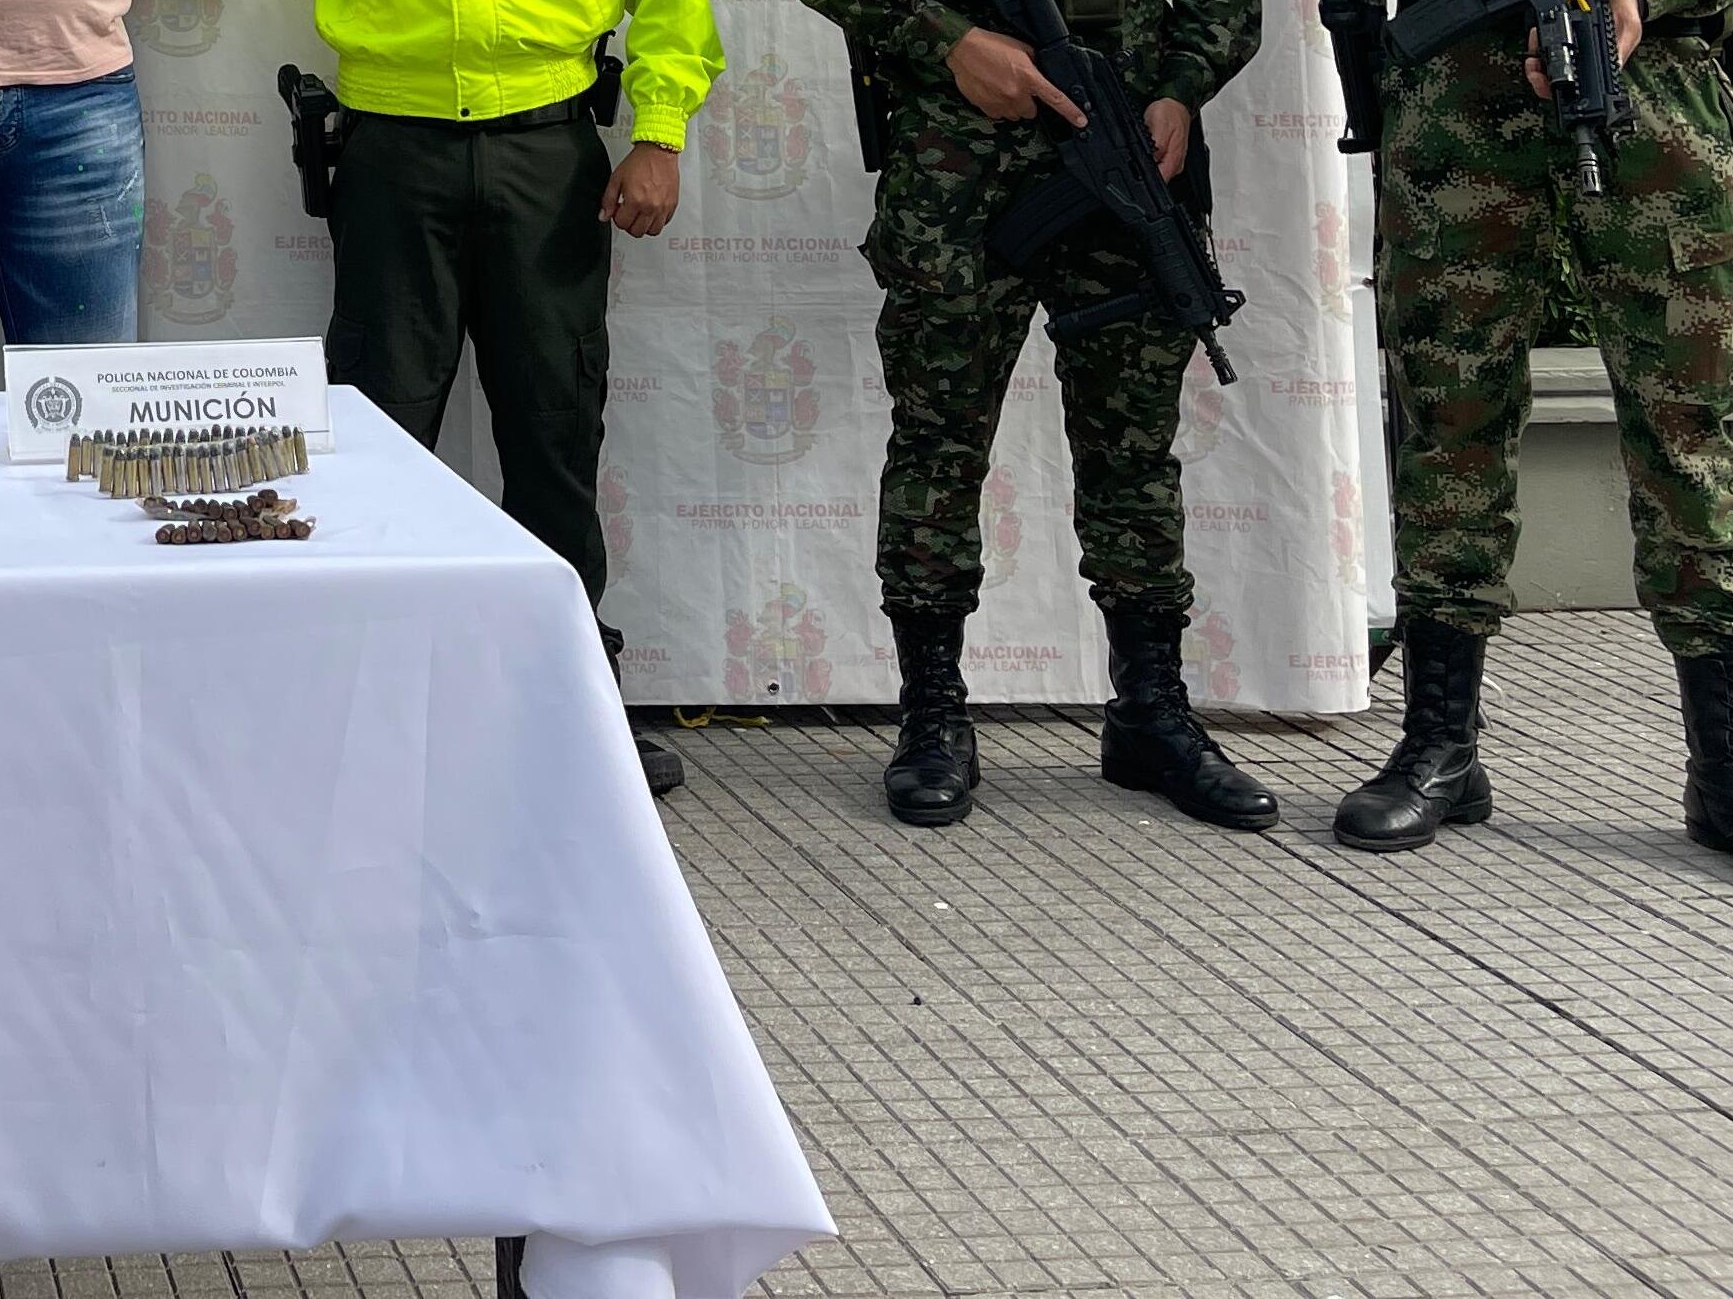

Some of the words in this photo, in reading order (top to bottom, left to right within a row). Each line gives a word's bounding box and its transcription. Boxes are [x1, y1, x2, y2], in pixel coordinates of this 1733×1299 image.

[183, 111, 262, 125] NACIONAL
[761, 237, 854, 250] NACIONAL
[787, 252, 840, 262] LEALTAD
[97, 372, 144, 384] POLICIA
[147, 369, 210, 382] NACIONAL
[214, 368, 228, 379] DE
[233, 367, 298, 378] COLOMBIA
[130, 391, 277, 423] MUNICIÓN
[770, 503, 864, 518] NACIONAL
[795, 518, 849, 529] LEALTAD
[969, 646, 1062, 659] NACIONAL
